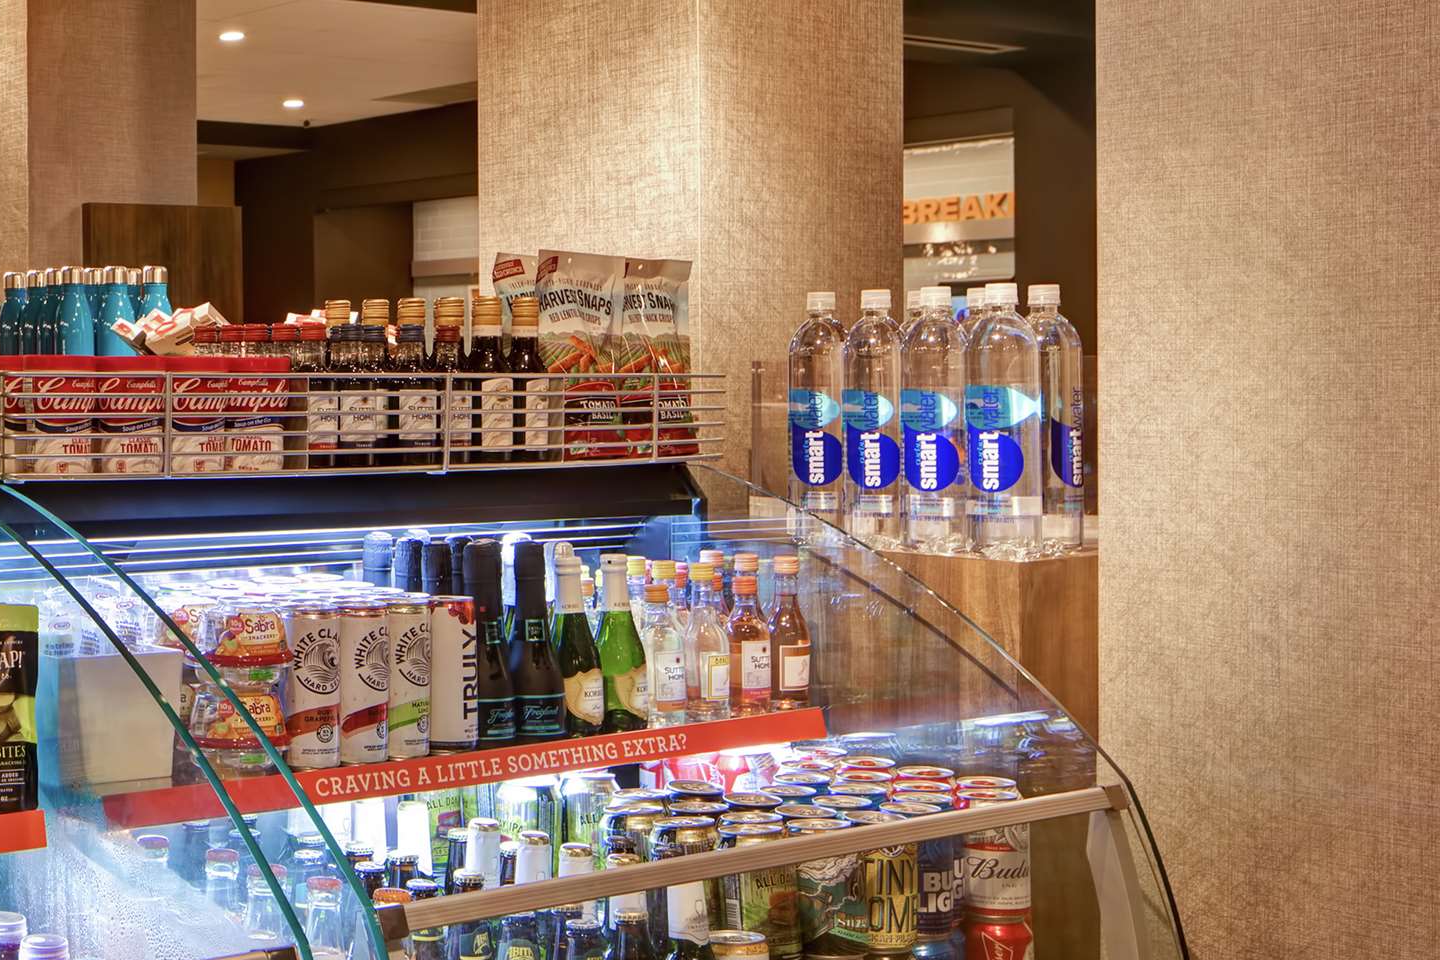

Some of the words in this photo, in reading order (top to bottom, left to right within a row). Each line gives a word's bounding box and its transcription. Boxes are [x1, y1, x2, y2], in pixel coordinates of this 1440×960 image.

[577, 289, 612, 316] SNAPS
[592, 411, 614, 420] BASIL
[660, 410, 684, 420] BASIL
[231, 439, 272, 452] TOMATO
[244, 618, 276, 635] Sabra
[293, 632, 317, 672] WHITE
[318, 628, 340, 645] CLA
[353, 630, 378, 670] WHITE
[394, 626, 418, 665] WHITE
[365, 674, 386, 689] HARD
[406, 670, 427, 684] HARD
[462, 628, 479, 721] TRULY
[303, 676, 328, 692] HARD
[315, 768, 411, 798] CRAVING
[417, 766, 432, 786] A
[435, 756, 503, 782] LITTLE
[507, 739, 619, 775] SOMETHING
[622, 733, 688, 759] EXTRA?
[426, 797, 443, 810] ALL
[755, 876, 777, 891] ALL
[923, 871, 952, 892] BU
[917, 891, 954, 913] LIG
